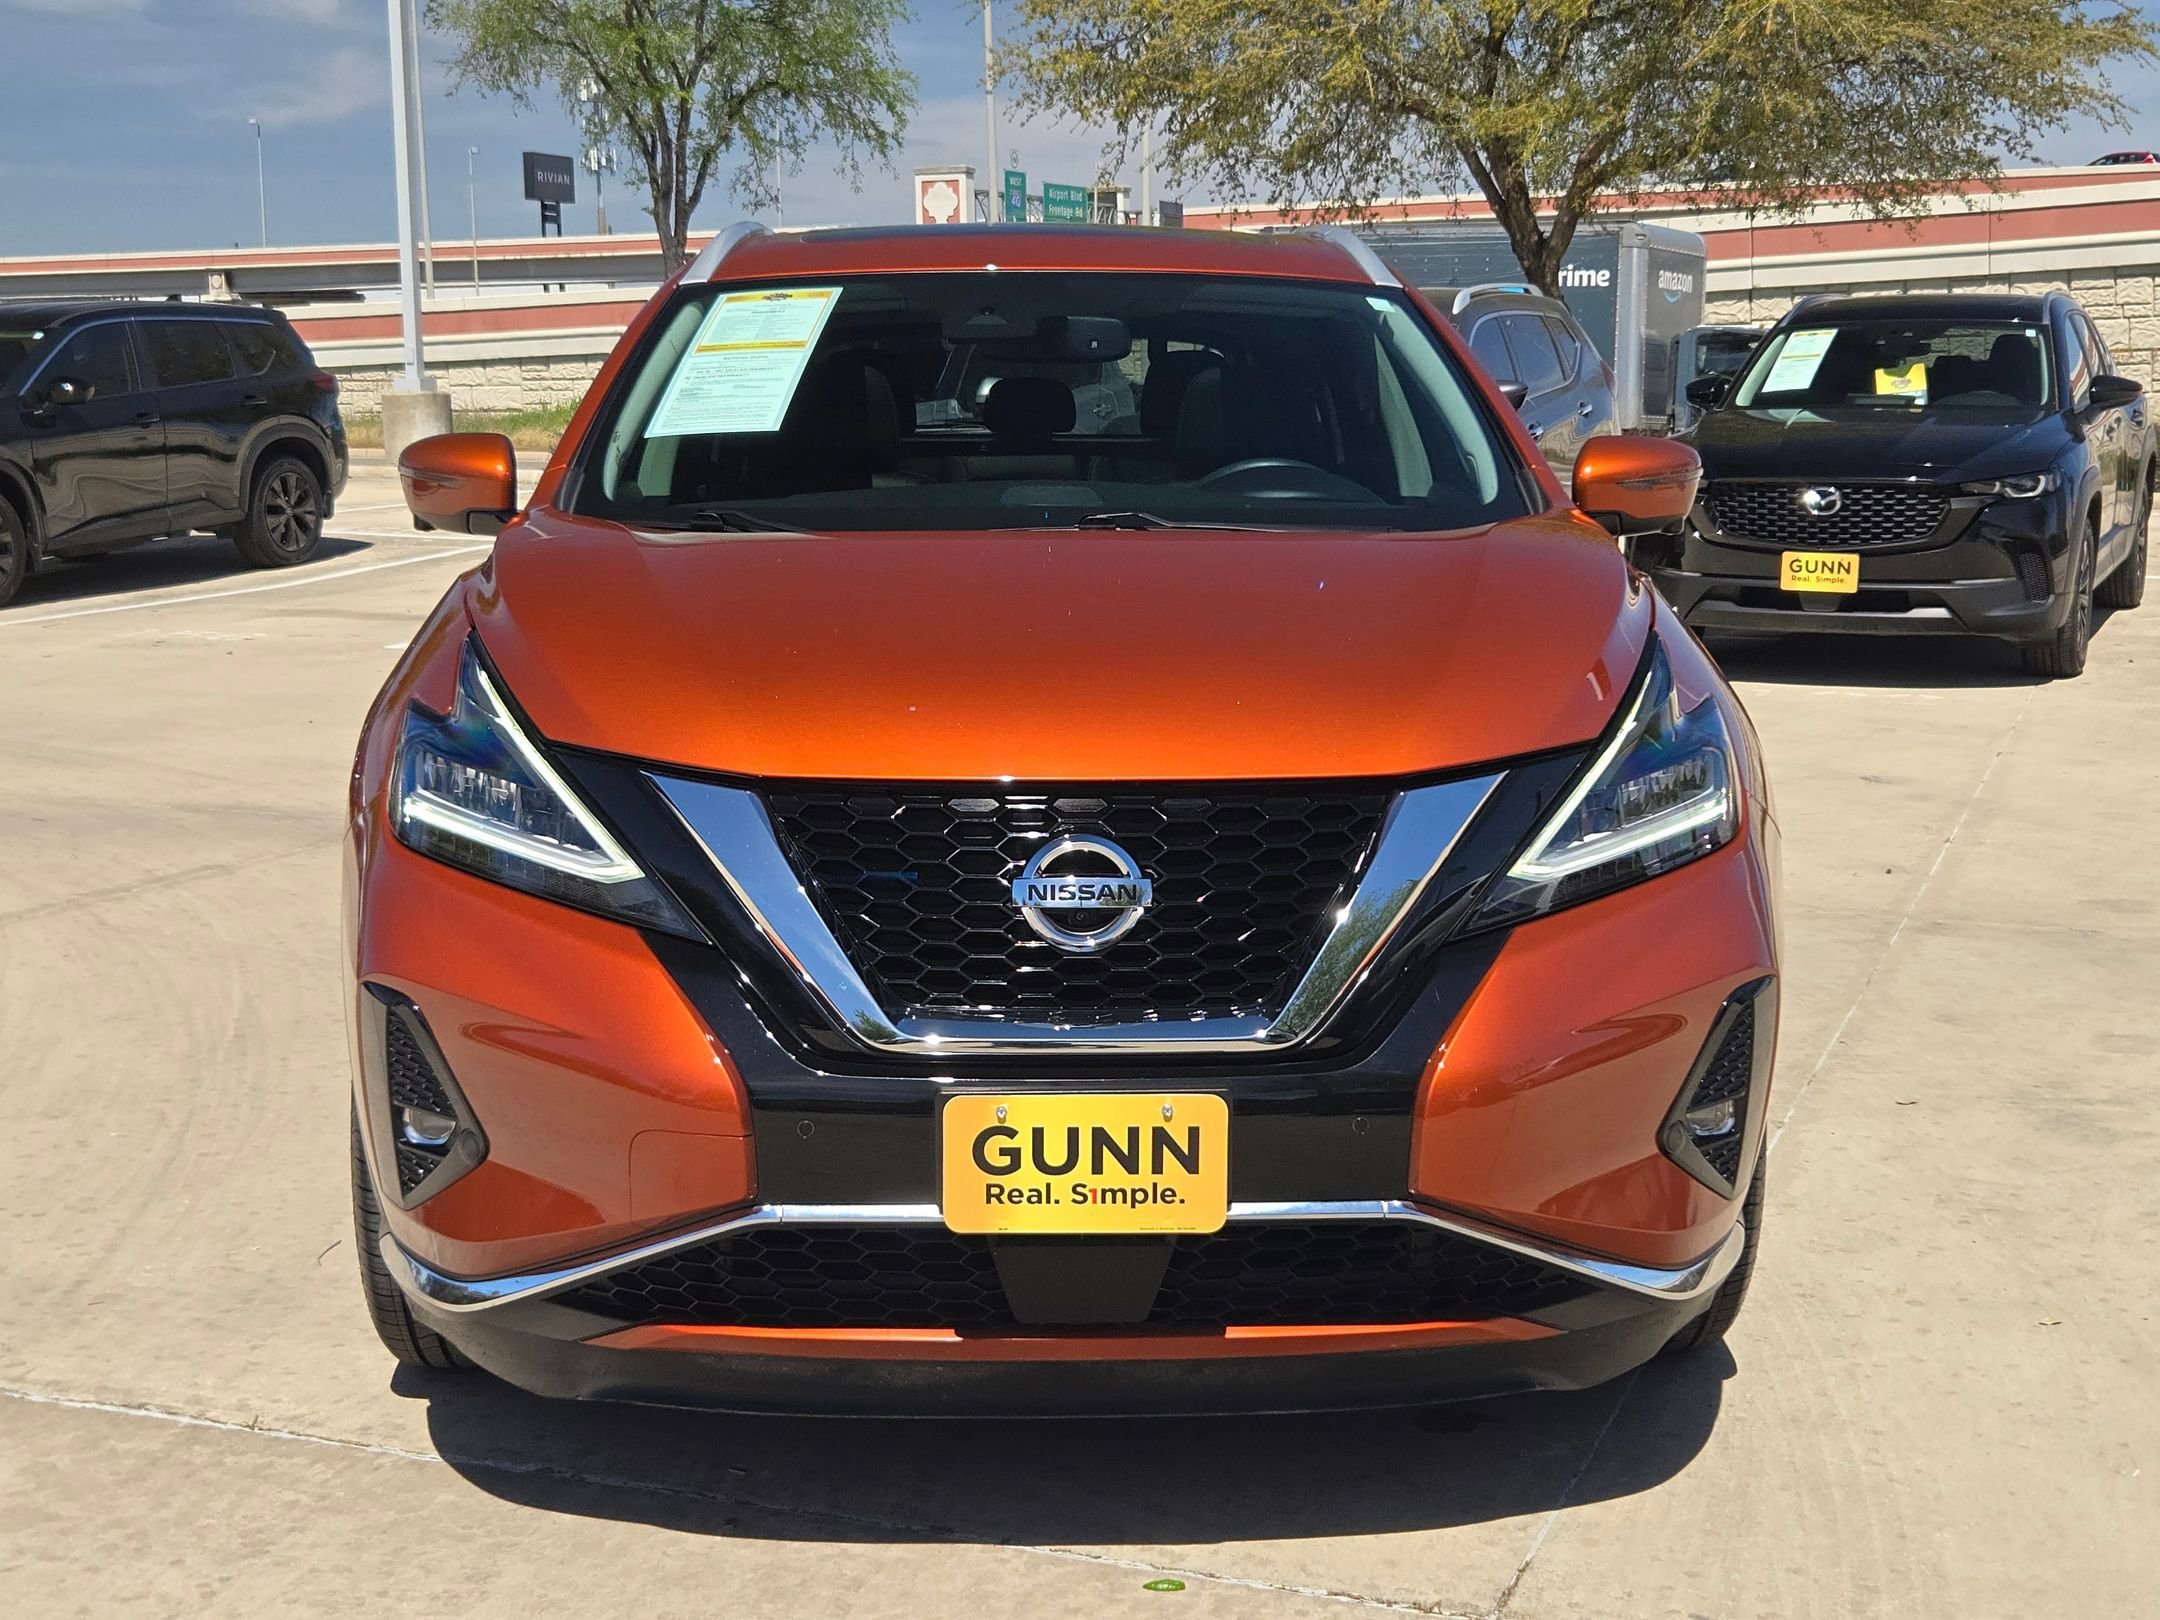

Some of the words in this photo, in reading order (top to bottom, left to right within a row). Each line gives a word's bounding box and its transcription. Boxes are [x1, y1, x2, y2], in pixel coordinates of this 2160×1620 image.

[537, 171, 570, 185] RIVIAN
[1048, 188, 1068, 202] Airport
[1070, 189, 1083, 202] Blvd
[1048, 203, 1073, 219] Frontage
[1074, 205, 1083, 218] Rd
[1558, 263, 1611, 288] rime
[1658, 269, 1693, 293] amazon
[1789, 558, 1851, 575] GUNN
[1791, 575, 1812, 583] Real.
[1028, 884, 1137, 901] NISSAN
[971, 1125, 1200, 1176] GUNN
[985, 1182, 1060, 1205] Real.
